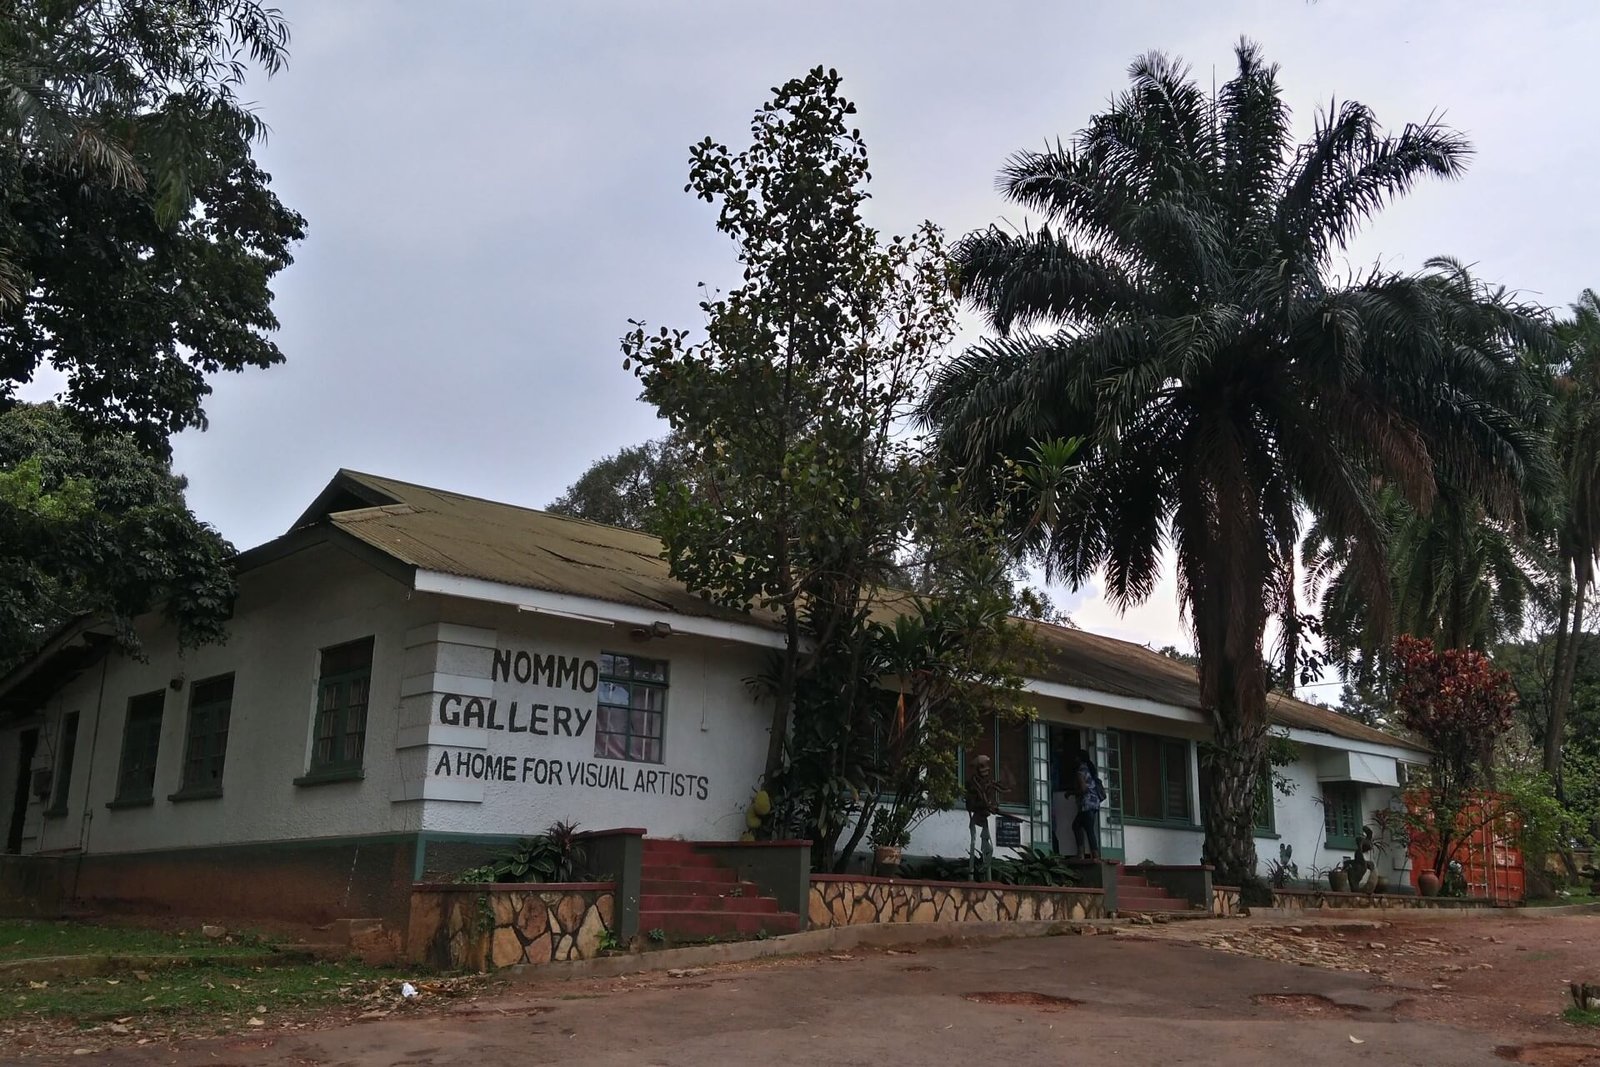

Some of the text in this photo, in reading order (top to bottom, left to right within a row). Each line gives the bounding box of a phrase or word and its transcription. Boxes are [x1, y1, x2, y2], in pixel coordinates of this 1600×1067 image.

[492, 649, 598, 693] NOMMO
[439, 694, 592, 737] GALLERY
[434, 751, 709, 800] A HOME FOR VISUAL ARTISTS
